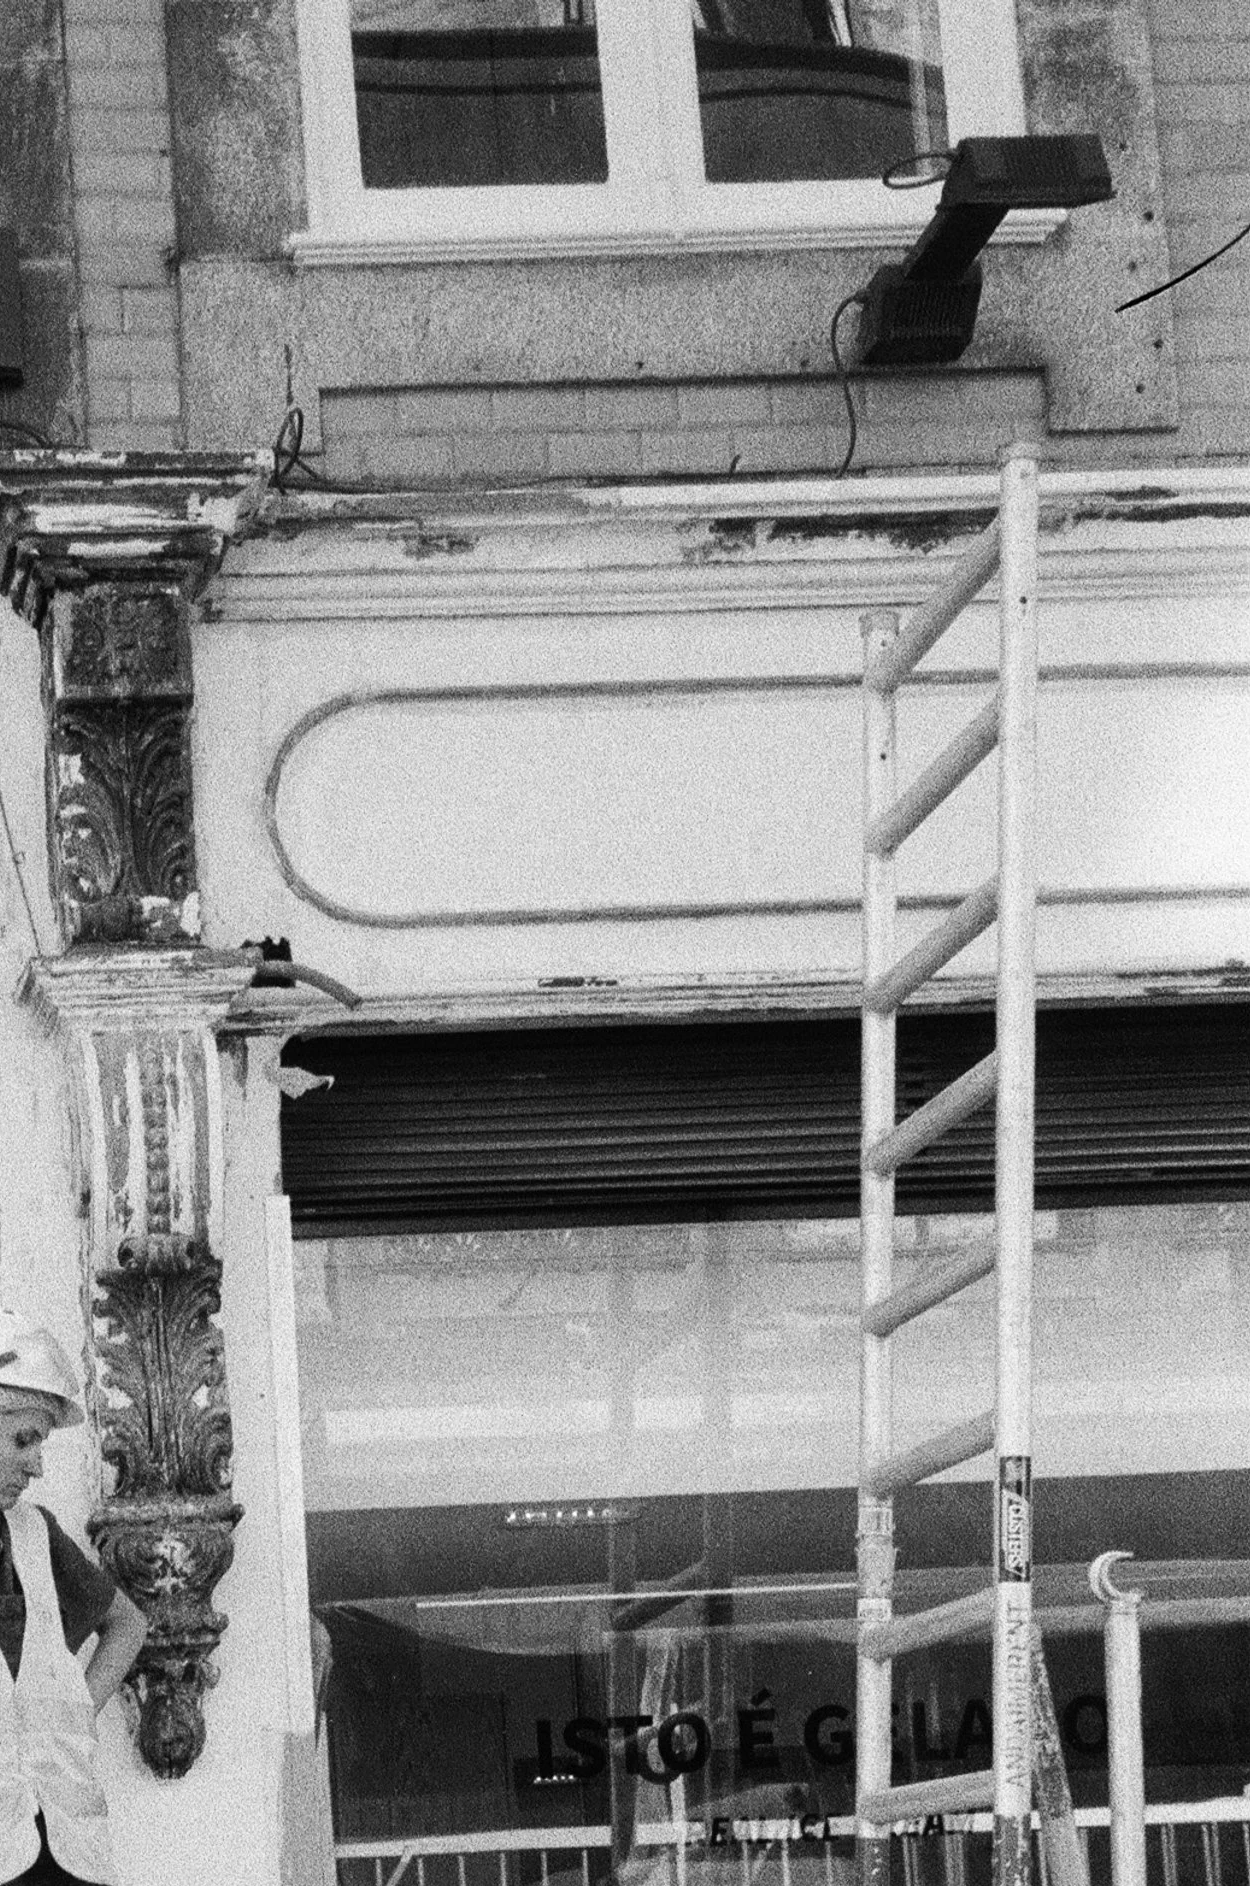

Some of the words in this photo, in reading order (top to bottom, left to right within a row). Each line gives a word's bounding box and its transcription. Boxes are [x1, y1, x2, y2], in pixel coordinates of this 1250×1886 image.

[537, 1712, 712, 1778] ISTO
[738, 1689, 780, 1770] É
[804, 1694, 1108, 1766] GLAO
